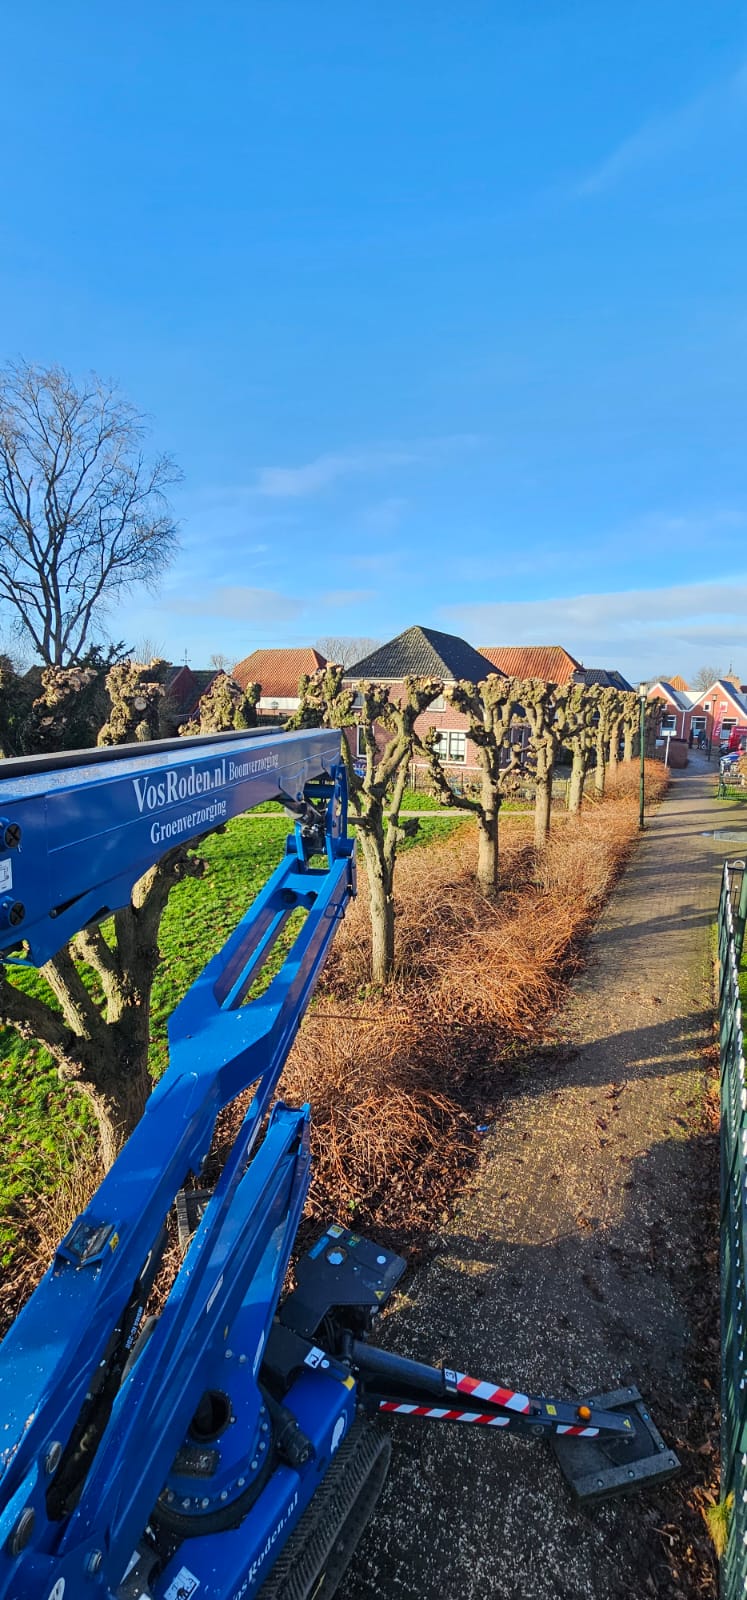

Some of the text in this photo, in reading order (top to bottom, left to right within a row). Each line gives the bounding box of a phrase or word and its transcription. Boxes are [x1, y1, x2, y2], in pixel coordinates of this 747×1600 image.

[132, 751, 279, 813] VosRoden.nl Boomverzorging
[151, 799, 227, 844] Groenverzorging
[232, 1491, 298, 1600] osRoden.nl
